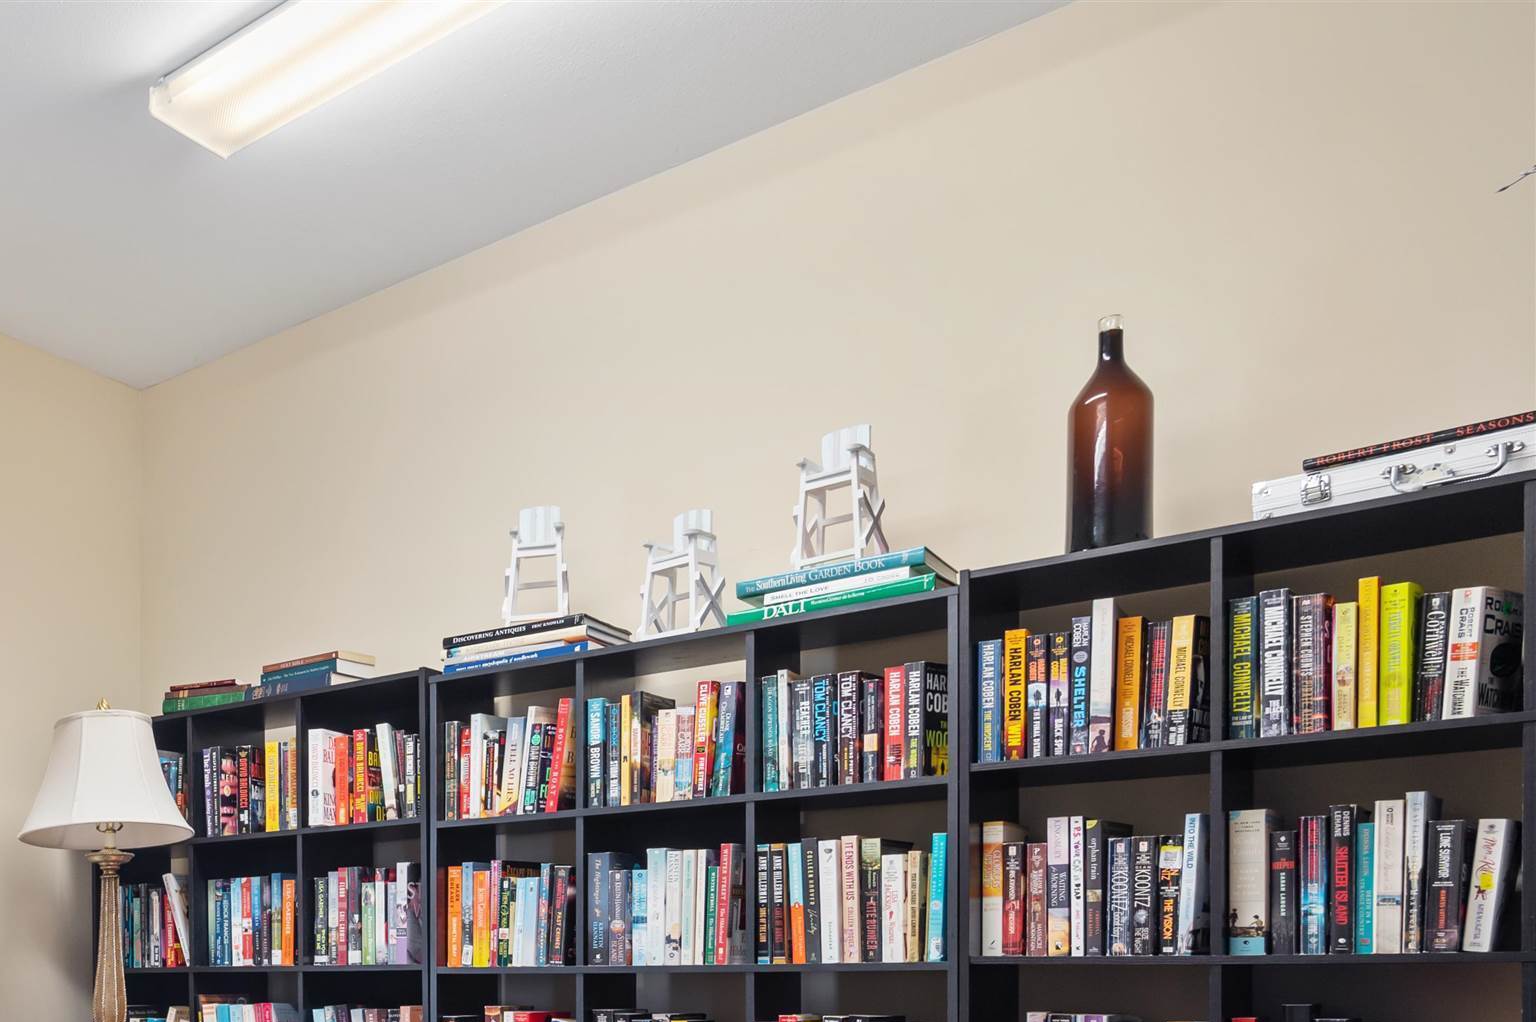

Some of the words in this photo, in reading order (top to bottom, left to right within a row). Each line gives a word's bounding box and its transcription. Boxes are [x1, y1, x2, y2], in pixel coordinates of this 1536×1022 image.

[1456, 412, 1535, 437] SEASONS
[1316, 446, 1376, 466] ROBERT
[1381, 434, 1434, 452] FROST
[854, 559, 884, 571] BOOK
[452, 630, 493, 644] DISCOVERING
[494, 625, 526, 636] ANTIQUES
[543, 619, 565, 628] KNOWLES
[1072, 624, 1081, 647] COBEN
[1233, 613, 1251, 659] MICHAEL
[1264, 606, 1283, 649] MICHAEL
[1300, 615, 1313, 647] STEPHEN
[1458, 608, 1468, 638] CRAIS
[1125, 635, 1136, 658] MICHAEL
[1424, 610, 1445, 664] Cornwell
[982, 644, 994, 679] HARLAN
[1009, 647, 1022, 686] HARLAN
[1124, 659, 1135, 686] CONNELLY
[1175, 647, 1188, 674] MICHAEL
[1263, 651, 1283, 696] CONNELLY
[699, 685, 707, 706] CLIVE
[814, 680, 825, 701] TOM
[841, 675, 851, 697] TOM
[889, 672, 901, 705] HARLAN
[908, 671, 920, 705] HARLAN
[982, 680, 994, 709] COBEN
[1073, 666, 1087, 728] SHELTER
[1173, 676, 1186, 707] CONNELLY
[1233, 663, 1251, 713] CONNELLY
[1009, 690, 1022, 721] COBEN
[590, 713, 600, 745] SANDRA
[698, 708, 707, 742] CUSSLER
[815, 704, 825, 742] CLANCY
[841, 701, 852, 738] CLANCY
[889, 707, 900, 736] COBEN
[908, 707, 919, 736] COBEN
[1007, 724, 1022, 747] WIN
[356, 742, 364, 761] DAVID
[509, 744, 517, 765] TELL
[530, 746, 539, 761] DAN
[590, 747, 601, 778] BROWN
[239, 758, 247, 777] DAVID
[356, 762, 364, 792] BALDACCI
[508, 768, 515, 780] NO
[526, 761, 538, 787] BROWN
[506, 783, 514, 802] LIES
[1188, 817, 1196, 835] INTO
[1334, 811, 1342, 837] LEHANE
[1342, 811, 1350, 836] DENNIS
[1089, 838, 1098, 862] orphan
[1187, 836, 1196, 849] THE
[1439, 832, 1451, 849] LONE
[759, 856, 768, 870] ANNE
[773, 856, 782, 871] ANNE
[806, 850, 814, 877] COLLEEN
[845, 850, 854, 870] ENDS
[1090, 864, 1098, 880] train
[1186, 851, 1194, 869] WILD
[1334, 846, 1348, 887] SHUTTER
[1437, 849, 1450, 878] SURVIVOR
[759, 872, 768, 903] HILLERMAN
[773, 872, 782, 903] HILLERMAN
[846, 871, 854, 890] WITH
[1050, 873, 1059, 906] MORNING
[1058, 871, 1066, 901] WAITING
[1111, 870, 1128, 911] KOONTZ
[1134, 869, 1151, 908] KOONTZ
[846, 891, 855, 901] US
[1164, 899, 1173, 912] THE
[1334, 891, 1348, 925] ISLAND
[867, 919, 877, 950] RUNNER
[1163, 914, 1173, 939] VISION
[617, 934, 625, 962] SUMMER
